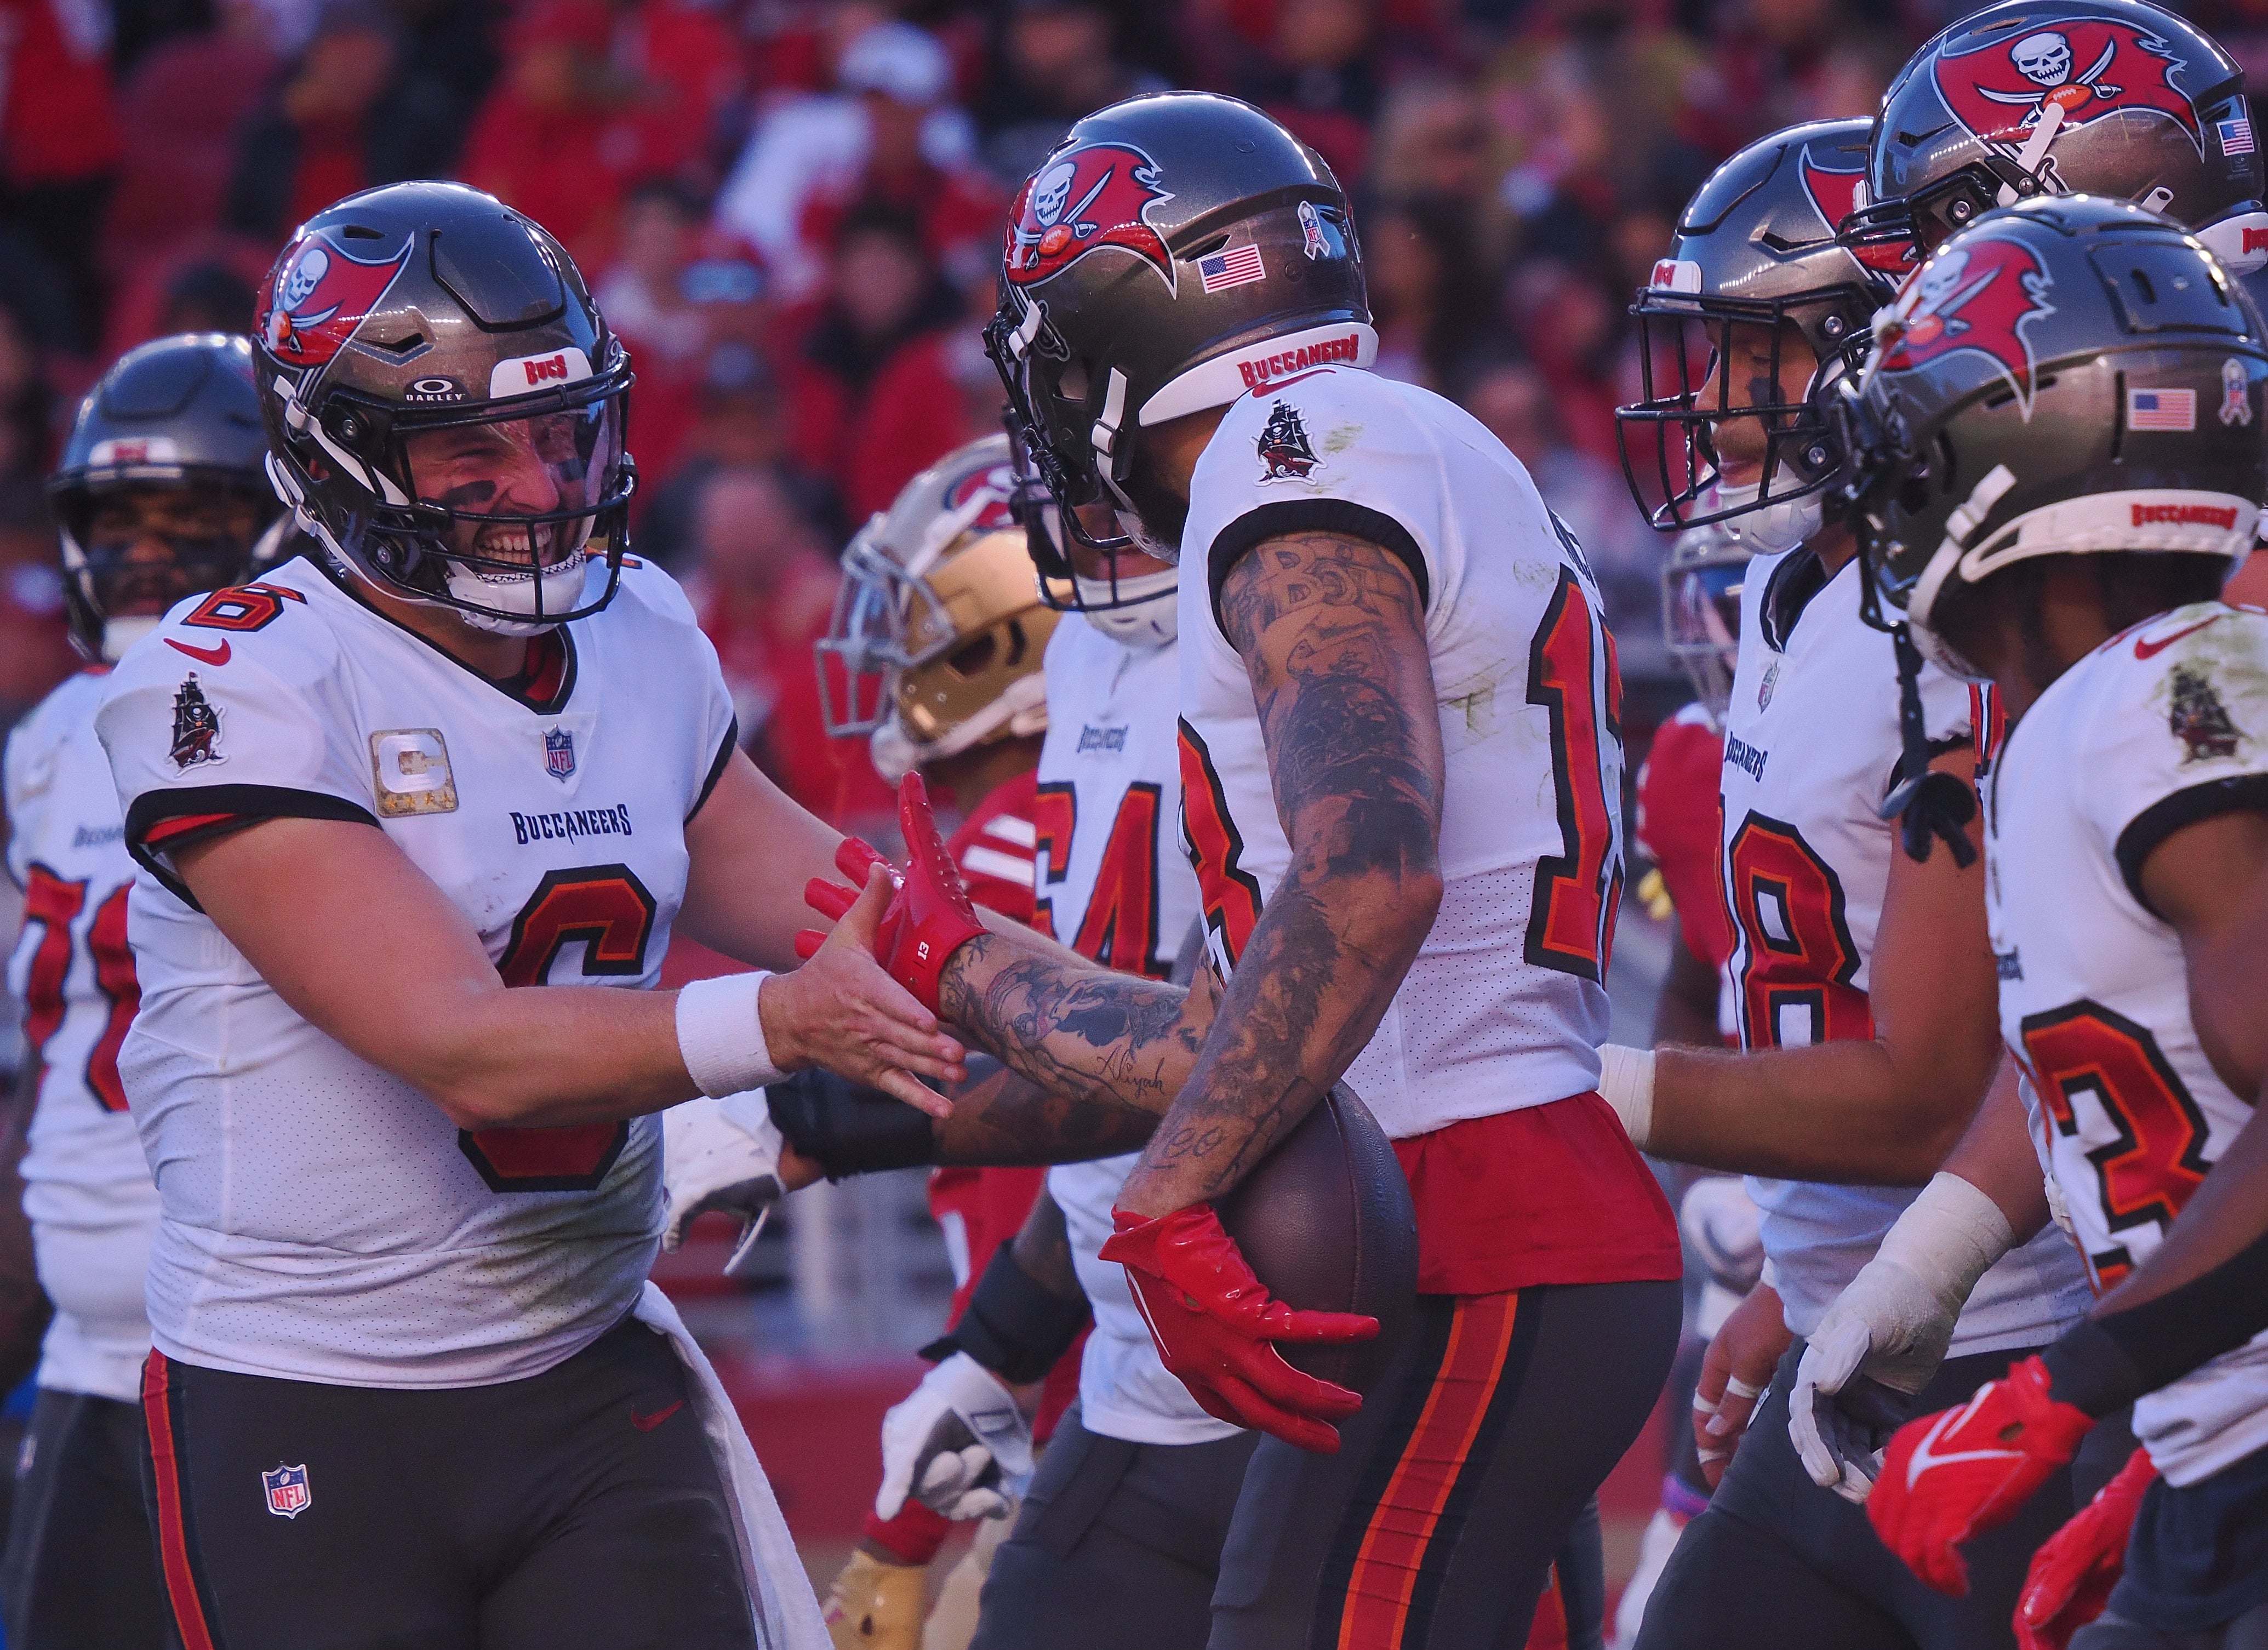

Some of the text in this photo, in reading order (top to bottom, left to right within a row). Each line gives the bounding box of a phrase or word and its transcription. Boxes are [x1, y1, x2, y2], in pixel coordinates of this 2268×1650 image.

[523, 354, 568, 385] BUCS
[180, 583, 308, 632] 6
[378, 734, 447, 793] C
[550, 750, 573, 771] NFL
[510, 803, 632, 845] BUCCANEERS
[1715, 792, 1876, 1051] 8
[917, 941, 929, 961] 13
[273, 1486, 304, 1508] NFL
